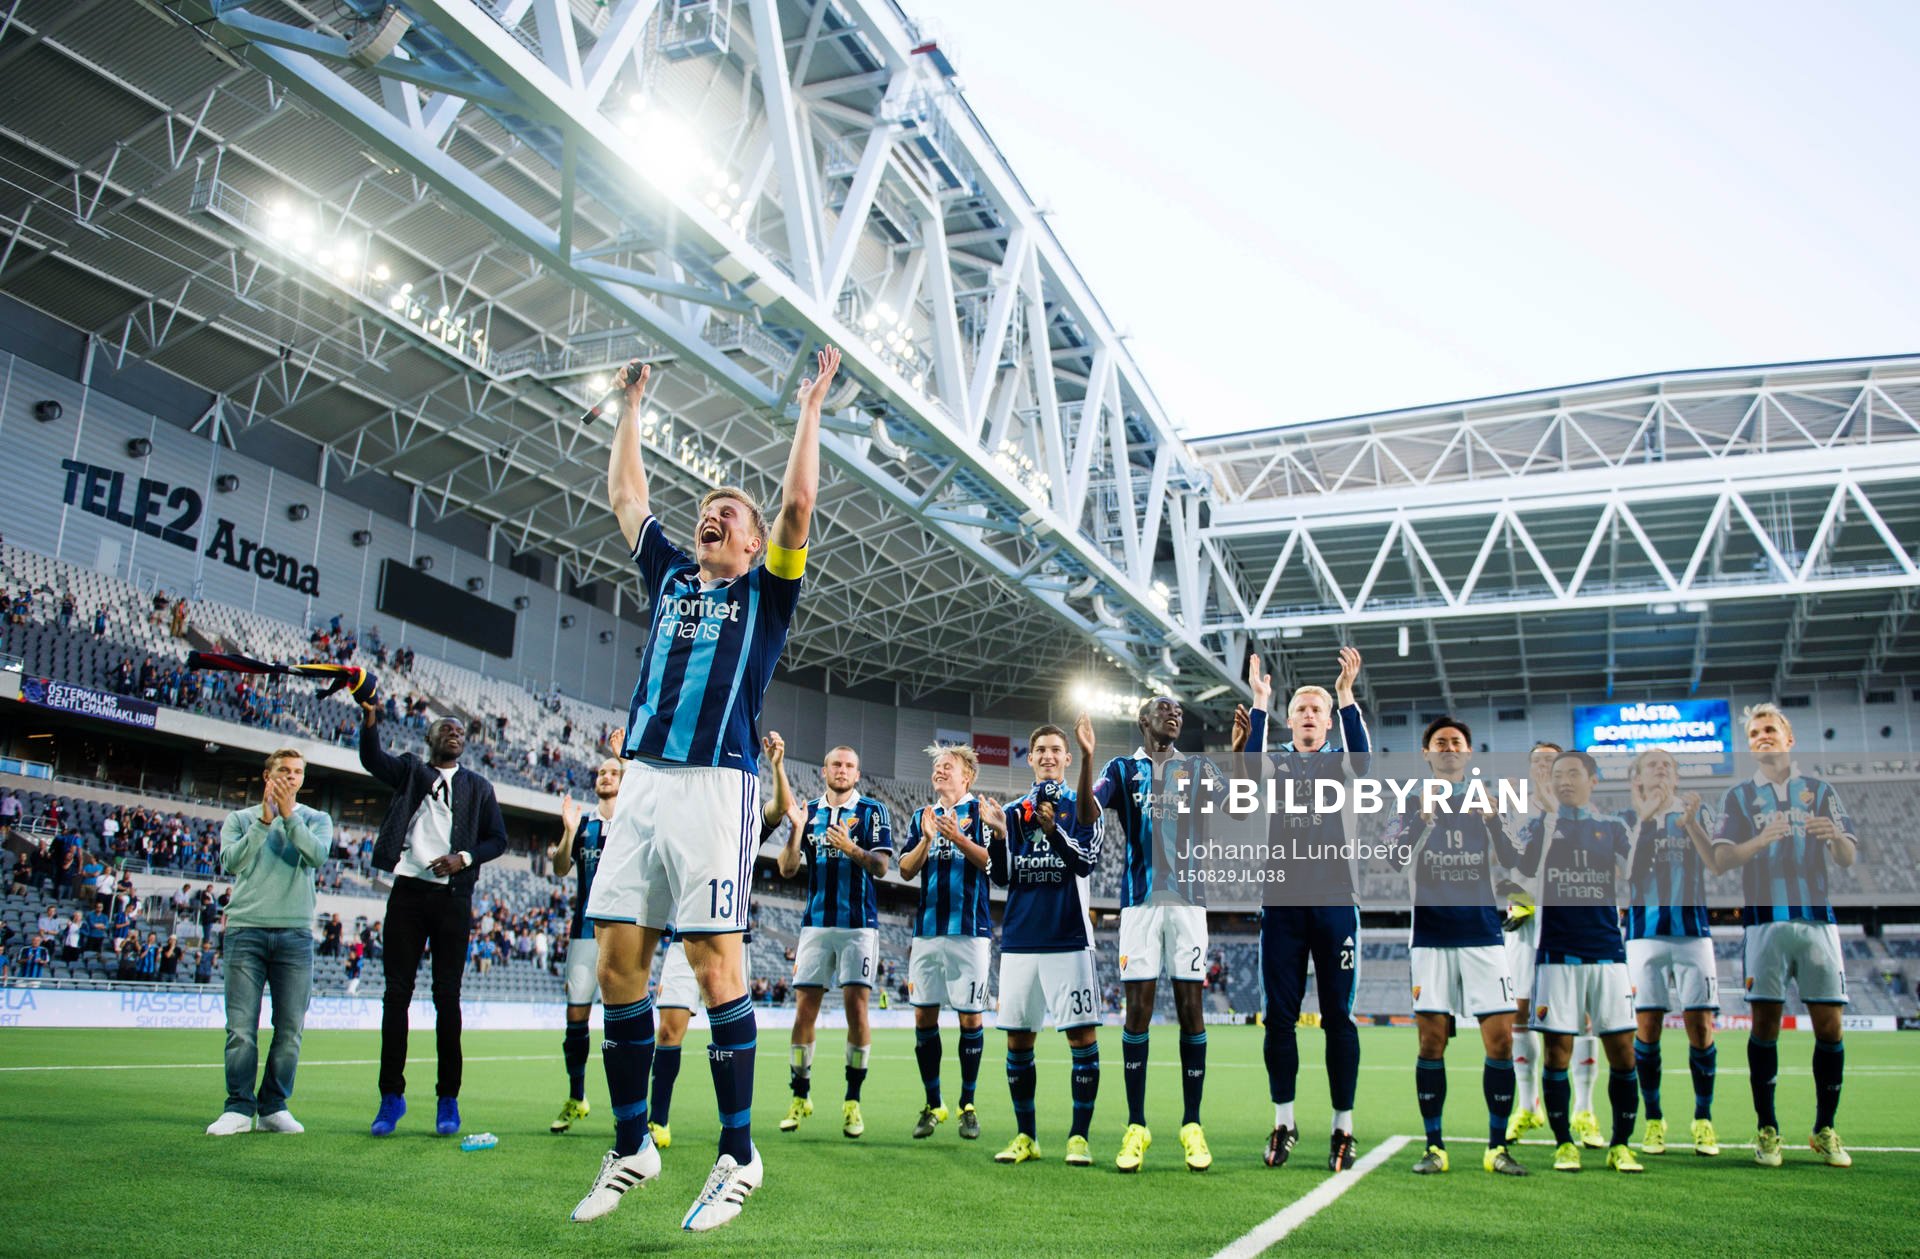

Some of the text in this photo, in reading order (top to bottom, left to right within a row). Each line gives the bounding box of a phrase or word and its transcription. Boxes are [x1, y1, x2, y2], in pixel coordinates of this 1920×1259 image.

[61, 458, 320, 598] TELE2 Arena
[657, 615, 720, 641] Finans
[47, 680, 118, 708] ÖSTERMALMS
[47, 694, 155, 726] GENTLEMANNAKLUBB
[1620, 703, 1681, 721] NÄSTA
[1445, 829, 1464, 849] 19
[1573, 849, 1588, 868] 11
[1019, 868, 1062, 883] Finans
[1431, 865, 1481, 881] Finans
[1548, 867, 1612, 884] Prioritet
[708, 879, 734, 919] 13
[1557, 883, 1605, 900] Finans
[862, 956, 870, 978] 6
[121, 992, 223, 1013] HASSELA
[1070, 989, 1092, 1015] 33
[708, 1050, 733, 1061] DIF
